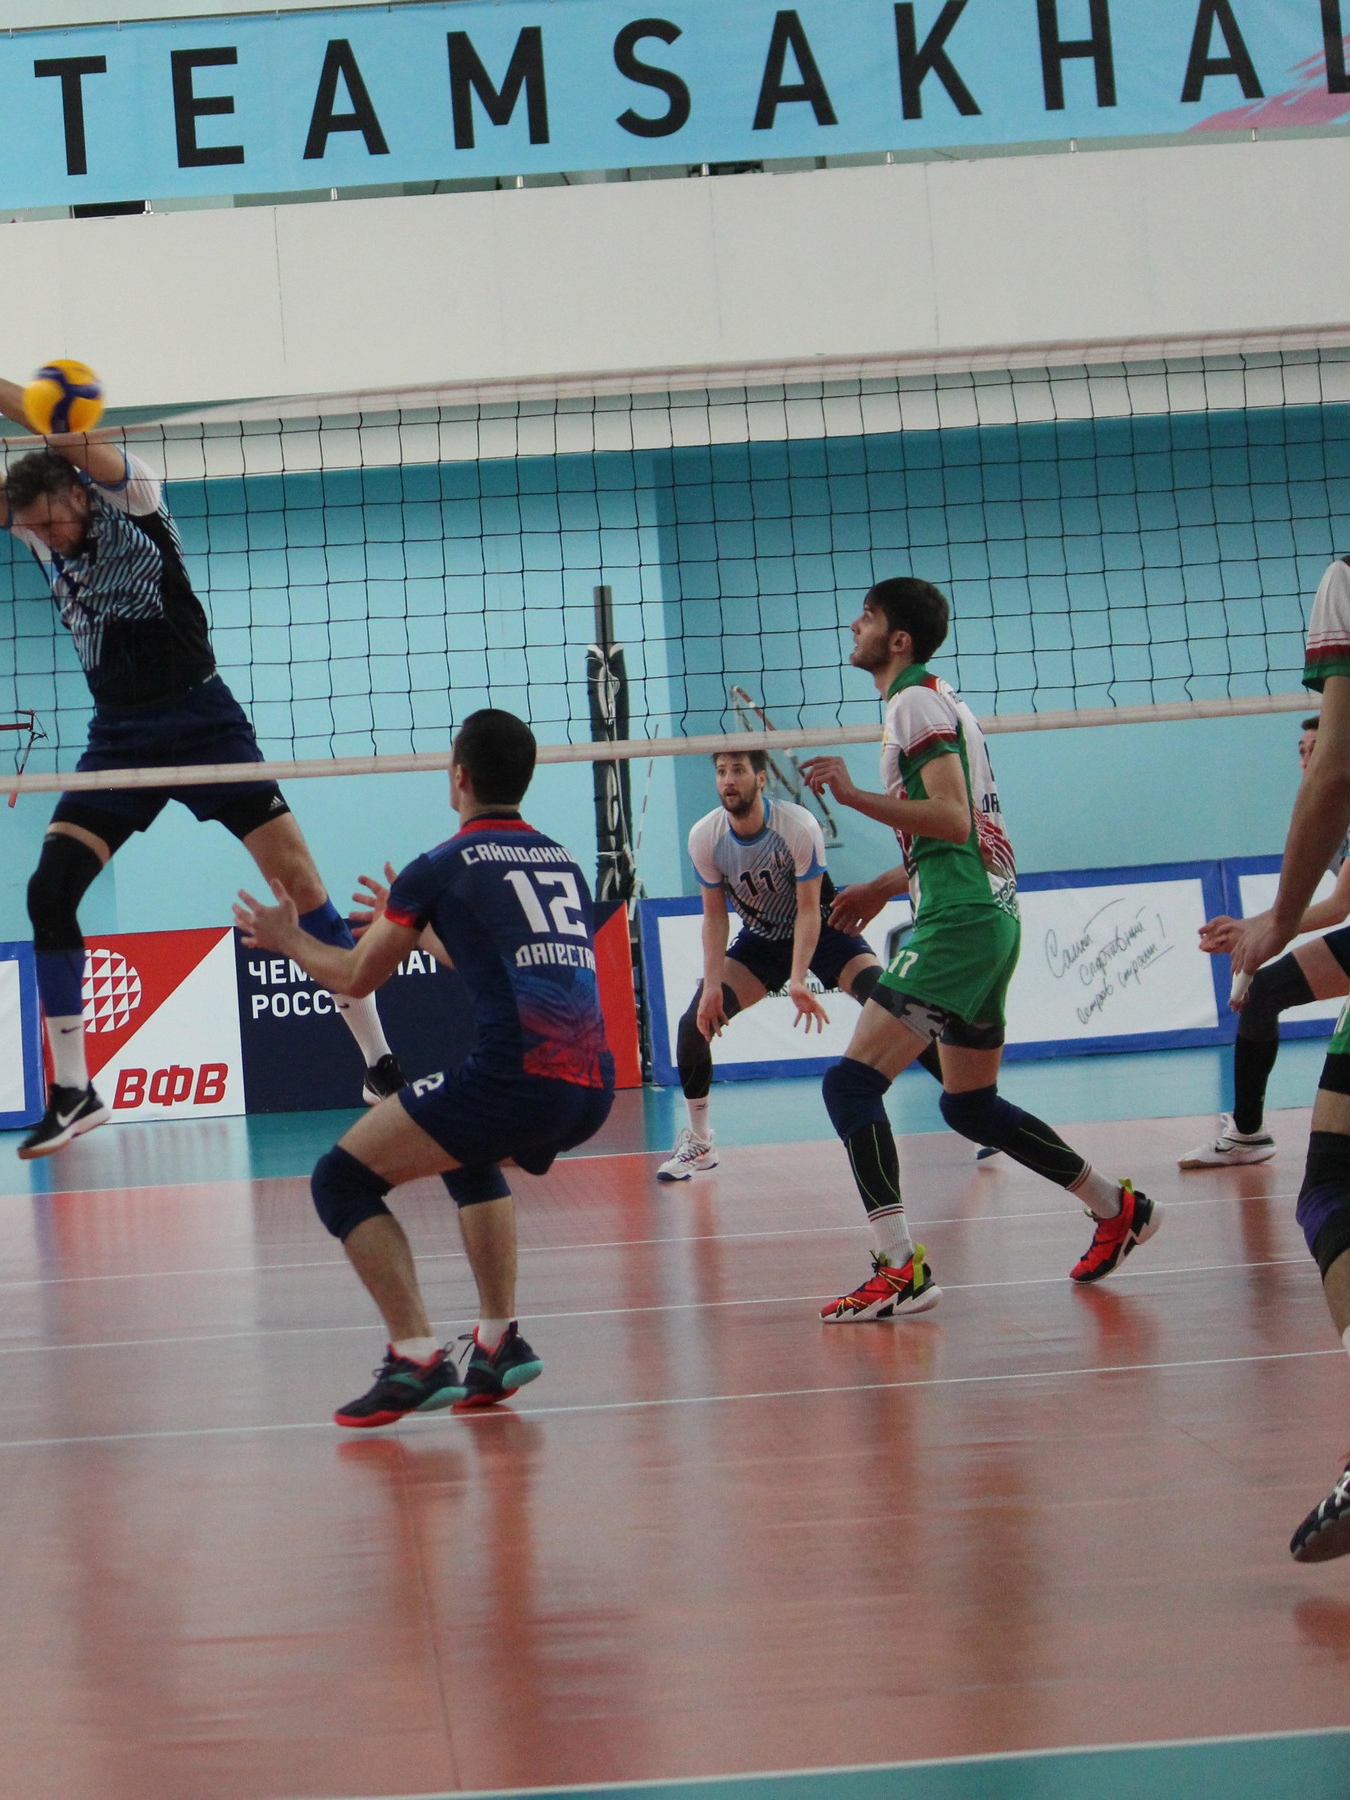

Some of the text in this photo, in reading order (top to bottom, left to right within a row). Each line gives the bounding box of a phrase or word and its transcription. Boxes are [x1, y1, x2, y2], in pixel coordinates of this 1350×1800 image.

[740, 870, 777, 897] 11
[503, 870, 588, 939] 12
[515, 943, 596, 973] ДАГЕСТА
[112, 1063, 229, 1109] ВФВ
